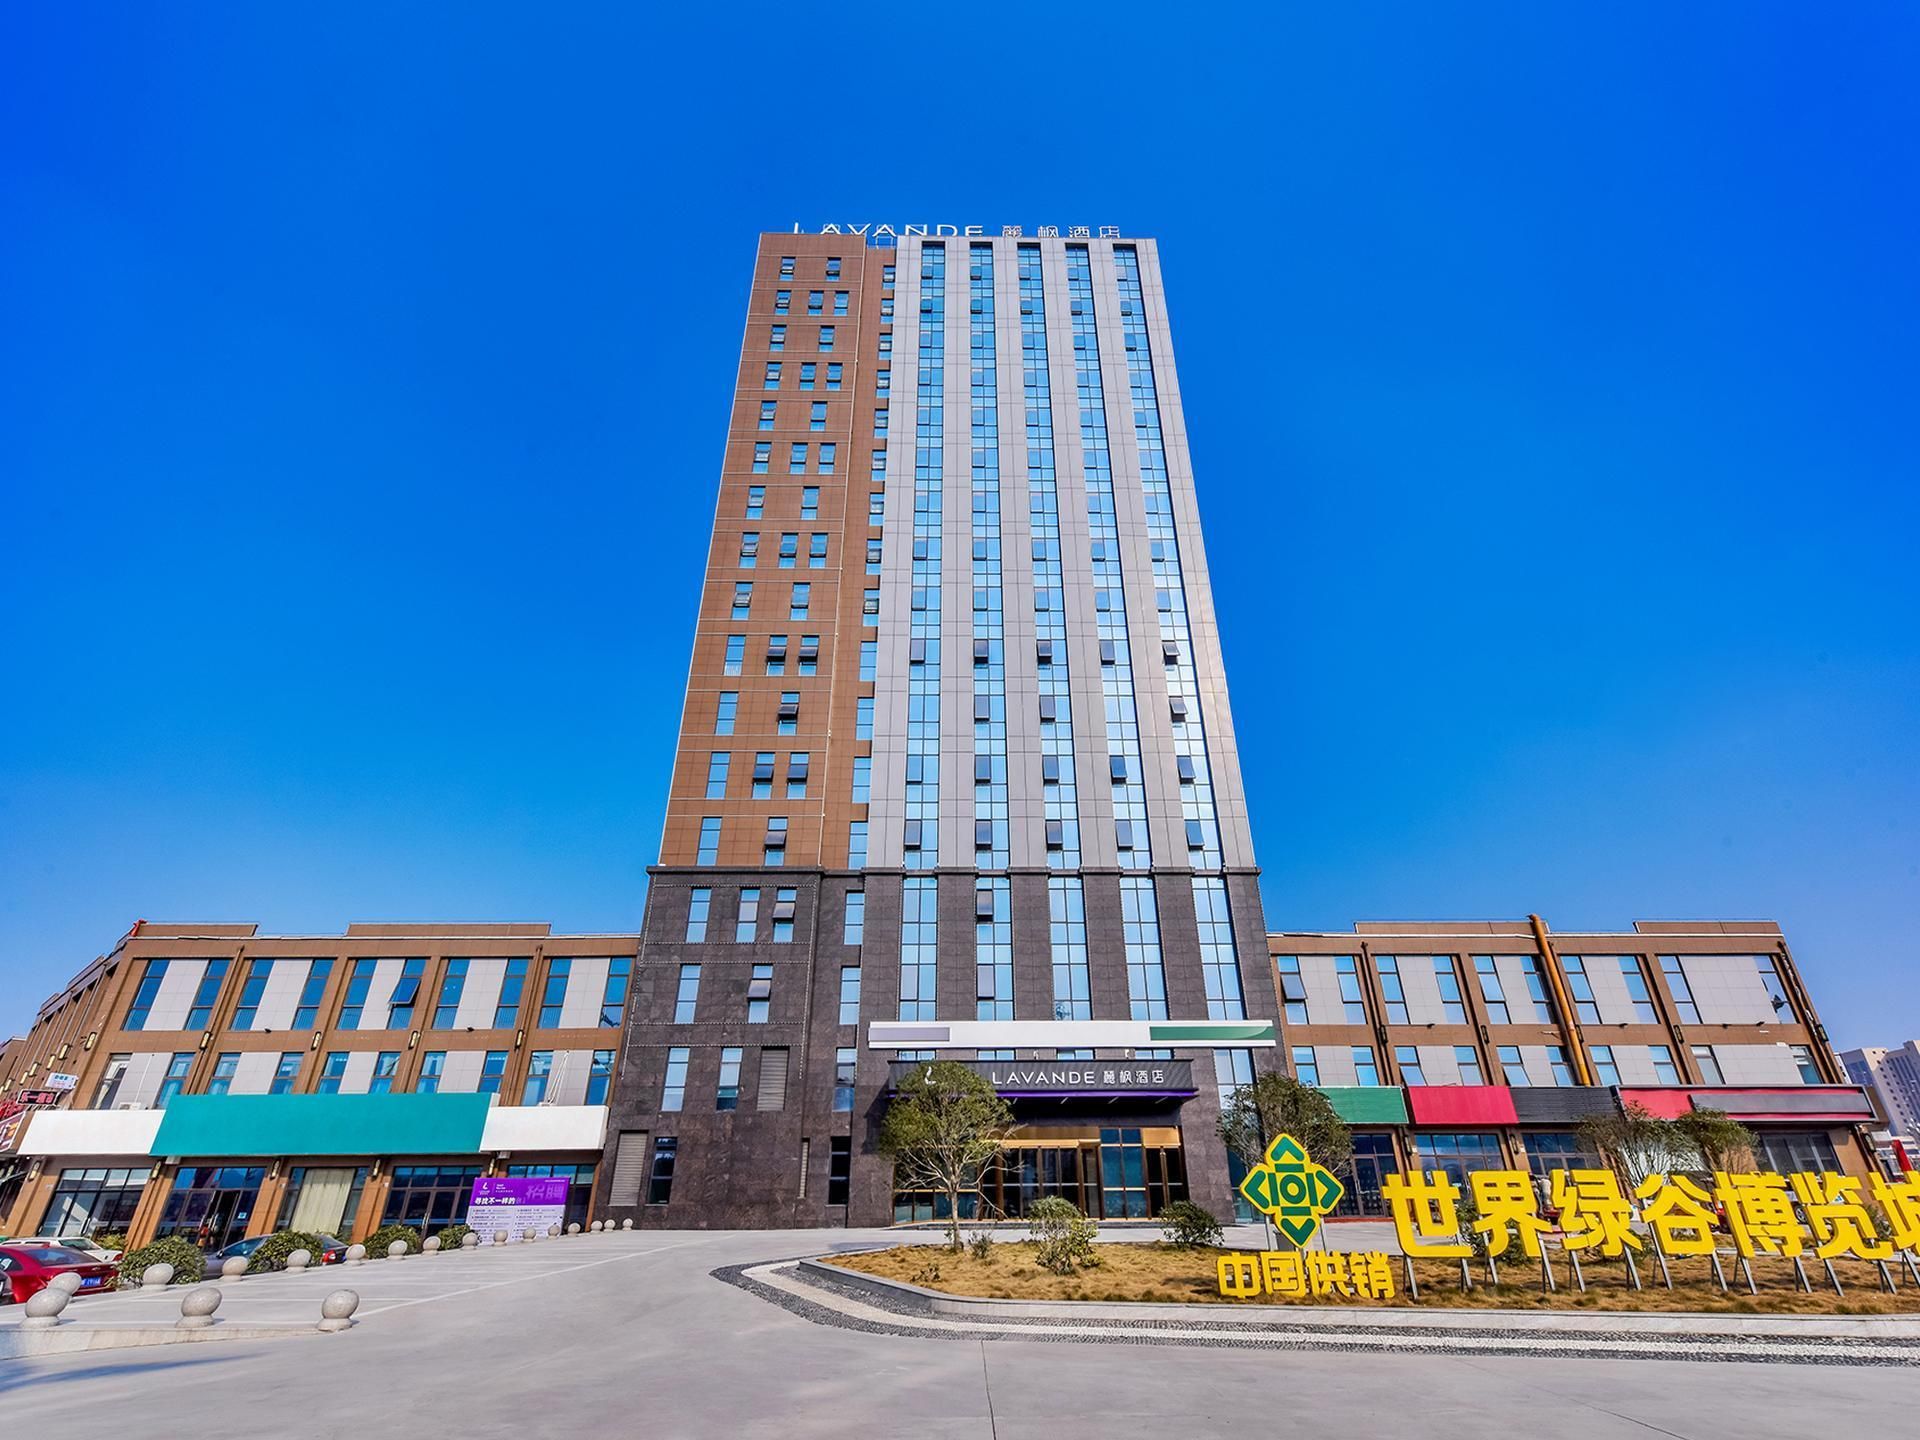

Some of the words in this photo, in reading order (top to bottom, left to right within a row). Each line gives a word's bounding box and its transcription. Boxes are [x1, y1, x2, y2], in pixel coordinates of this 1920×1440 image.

[793, 222, 984, 237] LAVANDE
[992, 1071, 1096, 1085] LAVANDE
[1217, 1250, 1396, 1299] 中国供销
